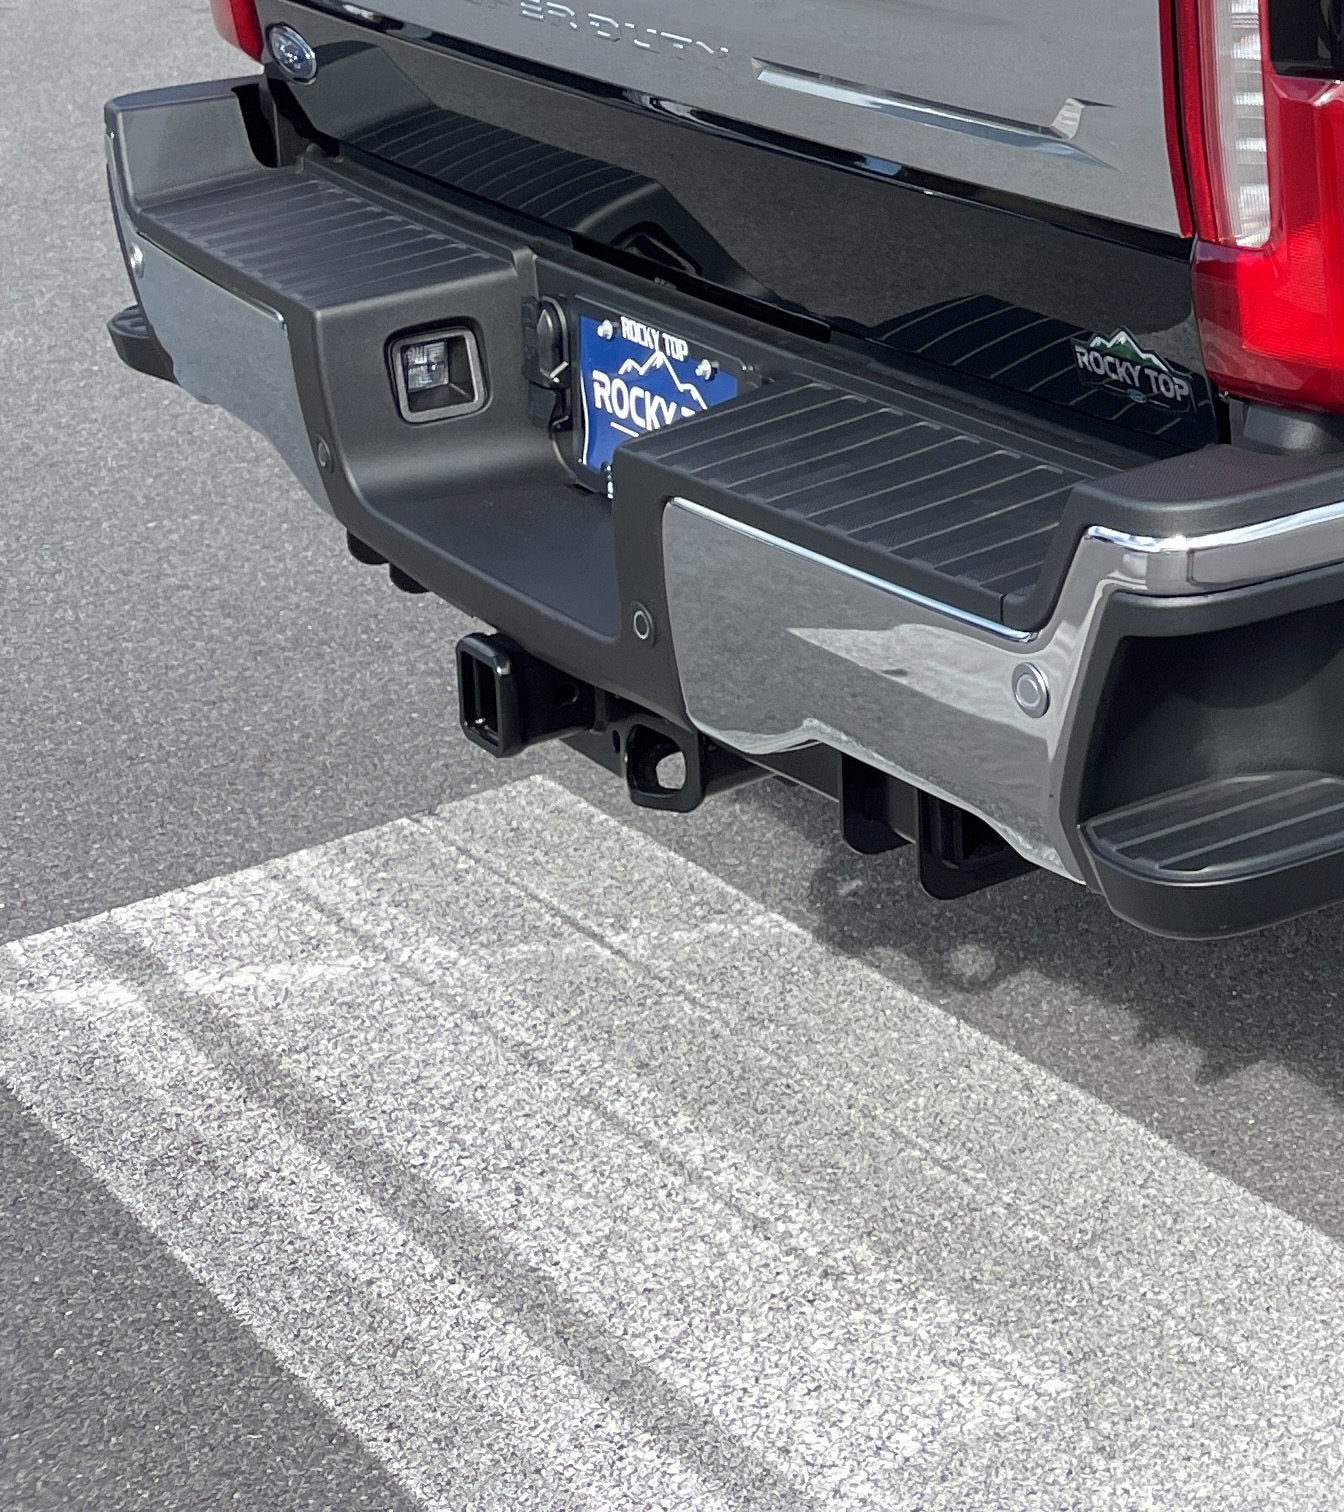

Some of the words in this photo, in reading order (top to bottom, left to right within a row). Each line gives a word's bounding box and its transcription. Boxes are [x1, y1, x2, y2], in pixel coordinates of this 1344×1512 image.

[620, 316, 663, 352] ROCKY
[663, 332, 690, 362] TOP
[592, 369, 677, 430] ROCKY
[1074, 345, 1143, 388] ROCKY
[1144, 367, 1189, 402] TOP
